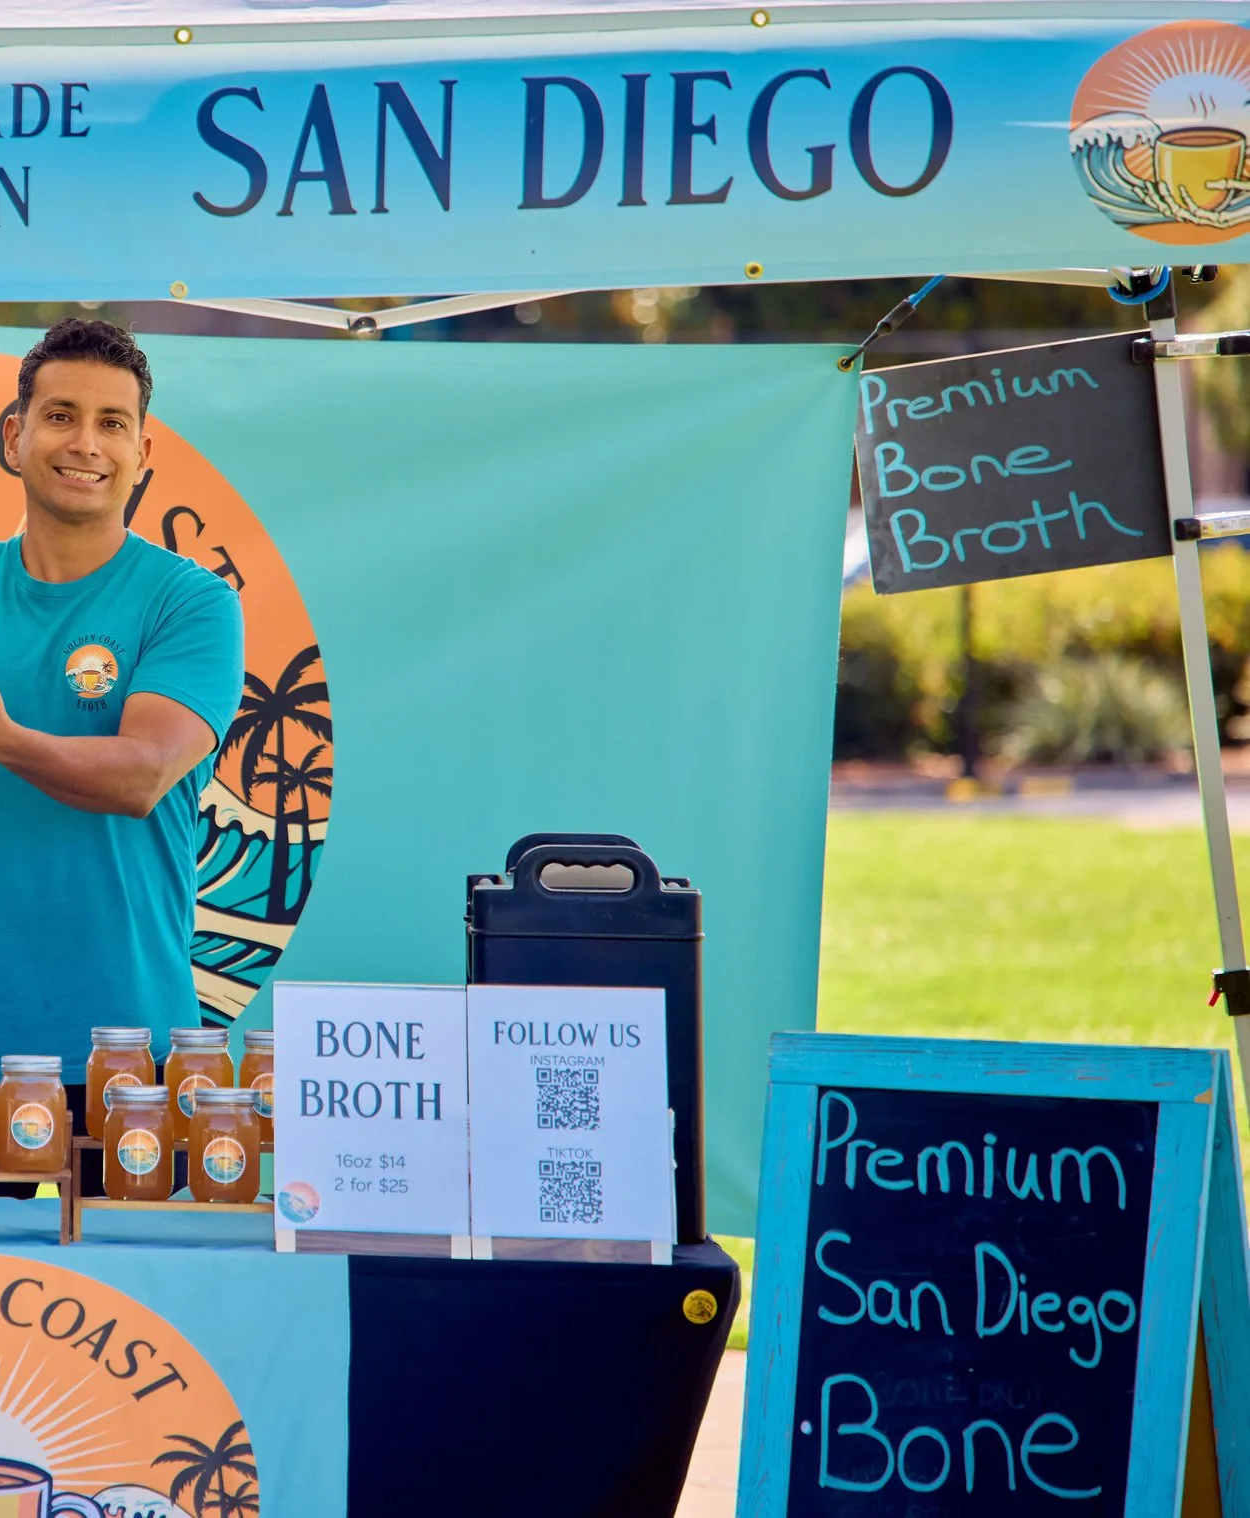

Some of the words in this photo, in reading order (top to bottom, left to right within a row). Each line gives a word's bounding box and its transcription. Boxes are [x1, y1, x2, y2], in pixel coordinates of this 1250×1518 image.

[192, 80, 459, 217] SAN
[516, 65, 954, 211] DIEGO
[859, 368, 1099, 435] Premium
[874, 441, 1073, 498] Bone
[889, 491, 1144, 574] Broth
[98, 634, 126, 655] COAST
[76, 699, 108, 712] BROTH
[315, 1020, 425, 1060] BONE
[493, 1021, 599, 1048] FOLLOW
[609, 1024, 642, 1048] US
[530, 1055, 606, 1068] INSTAGRAM
[300, 1080, 443, 1121] BROTH
[336, 1153, 373, 1170] 16oz
[379, 1153, 406, 1171] $14
[547, 1147, 594, 1160] TIKTOK
[816, 1090, 1128, 1210] Premium
[334, 1177, 345, 1193] 2
[350, 1177, 374, 1193] for
[378, 1177, 410, 1195] $25
[814, 1229, 955, 1337] San
[975, 1242, 1137, 1369] Diego
[818, 1373, 1103, 1499] Bone
